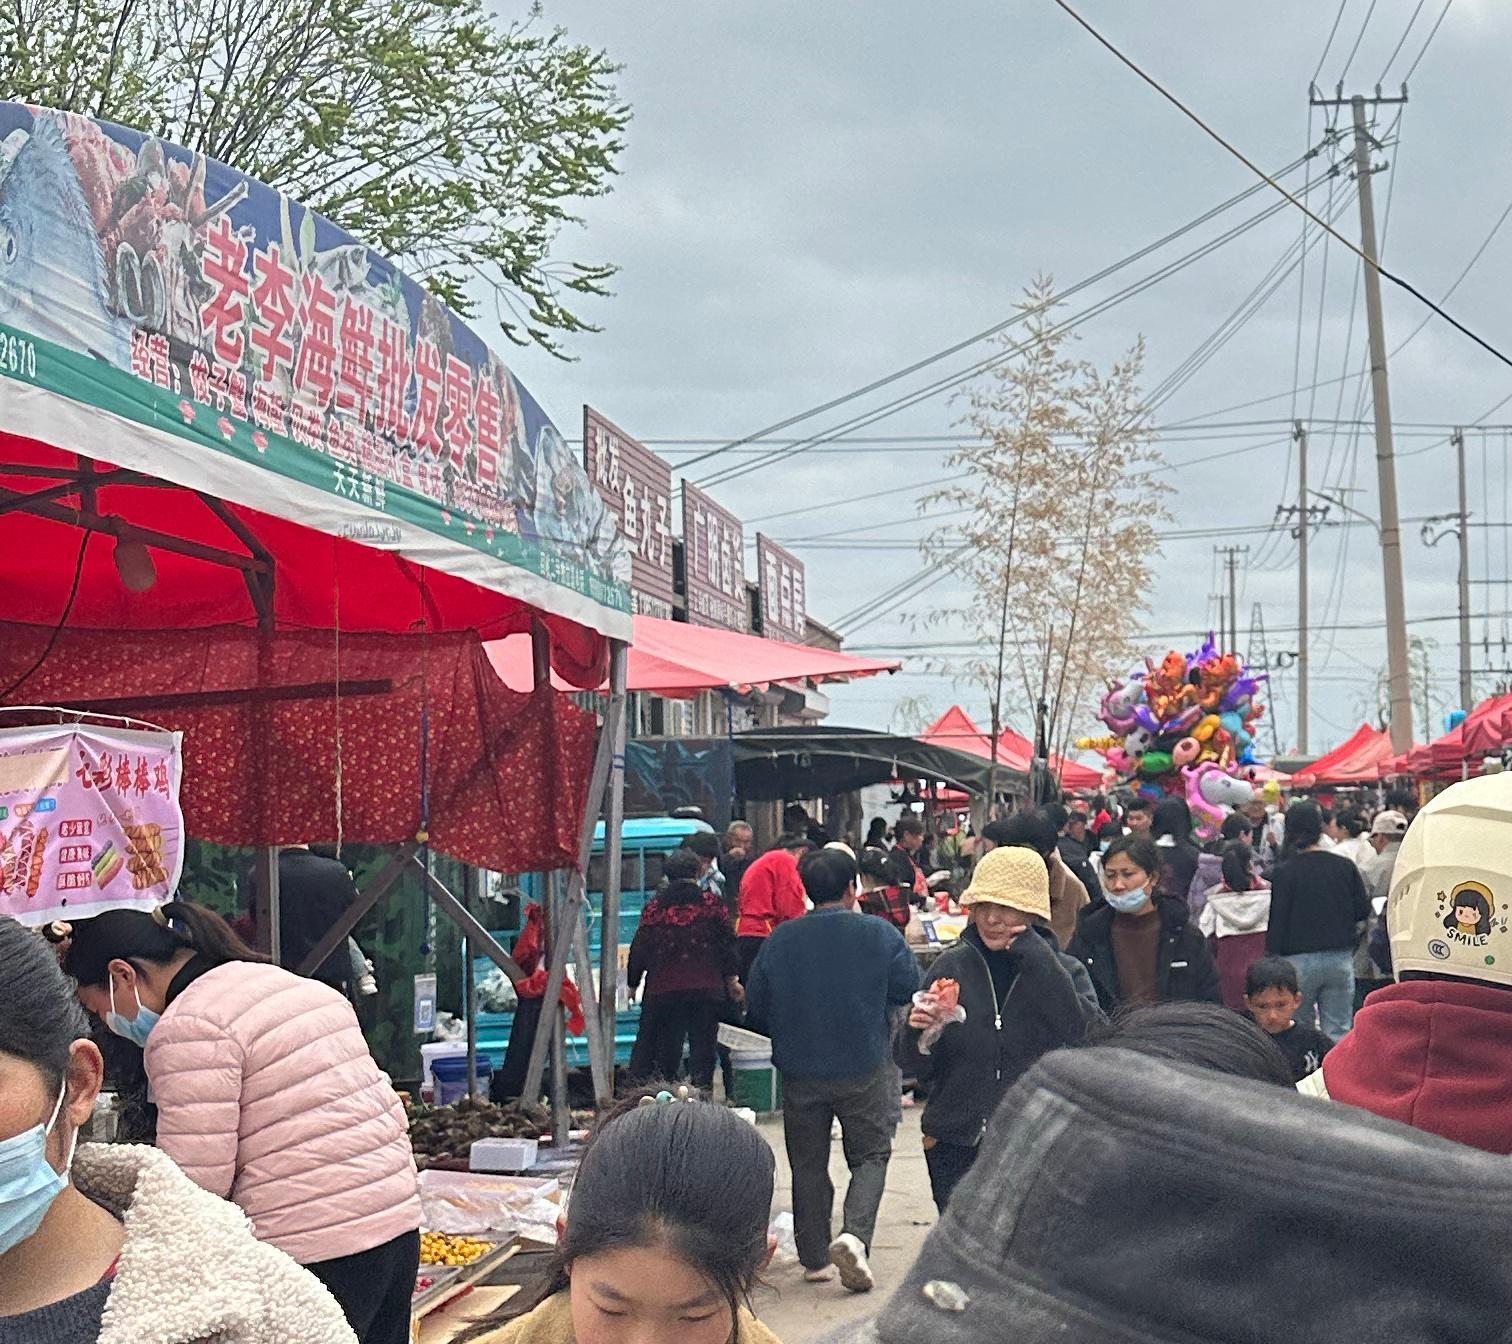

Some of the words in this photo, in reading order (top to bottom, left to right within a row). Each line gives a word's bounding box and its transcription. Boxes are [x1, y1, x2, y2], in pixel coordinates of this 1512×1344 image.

[201, 214, 500, 485] 老李海鲜批发零售
[595, 425, 620, 494] 批发
[623, 473, 670, 568] 鱼丸子
[75, 750, 170, 800] 七彩棒棒鸡
[1446, 928, 1489, 947] SMILE
